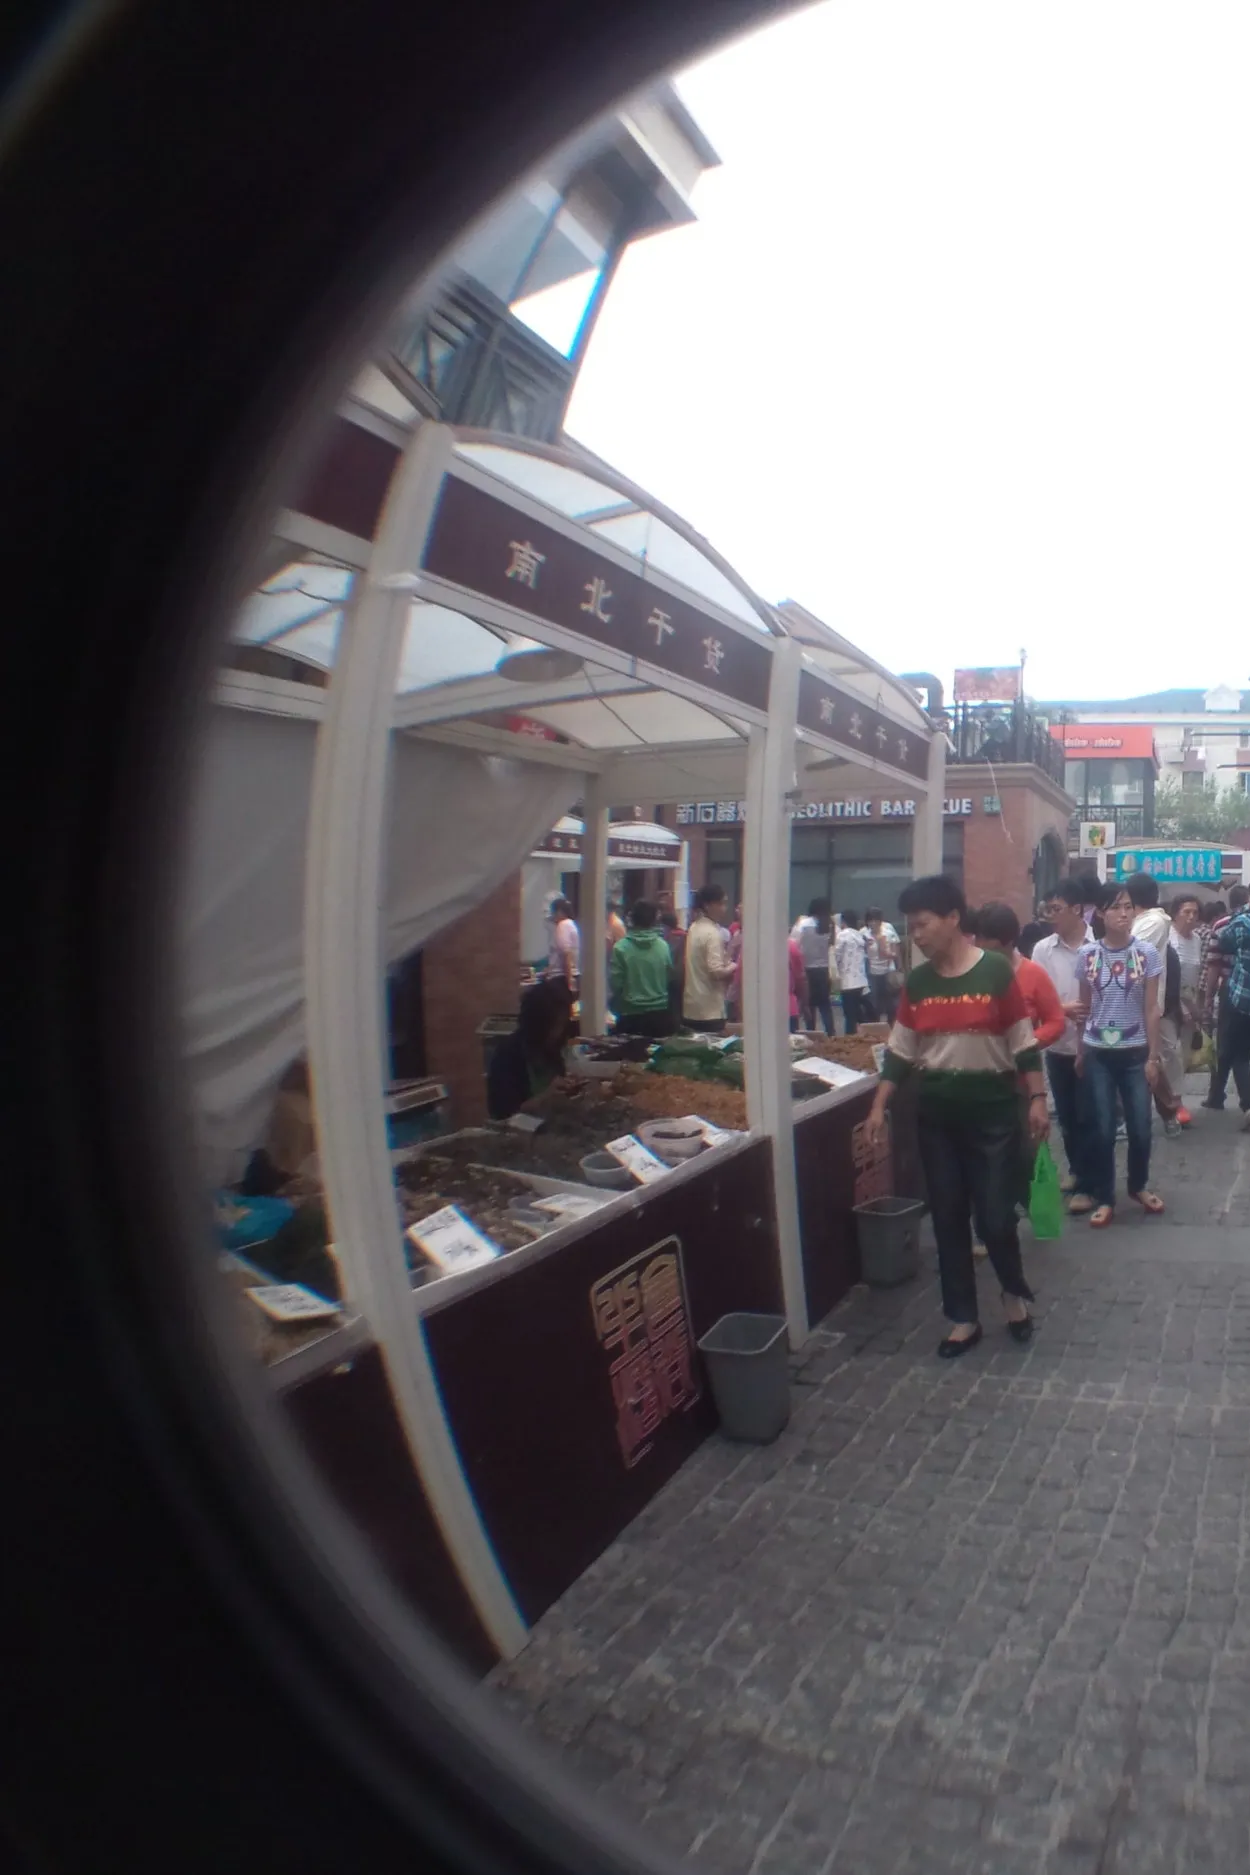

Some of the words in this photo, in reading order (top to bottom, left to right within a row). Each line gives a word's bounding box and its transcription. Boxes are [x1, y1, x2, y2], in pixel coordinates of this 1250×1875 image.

[505, 540, 725, 675] 南北干货
[788, 800, 872, 818] EOLITHIC
